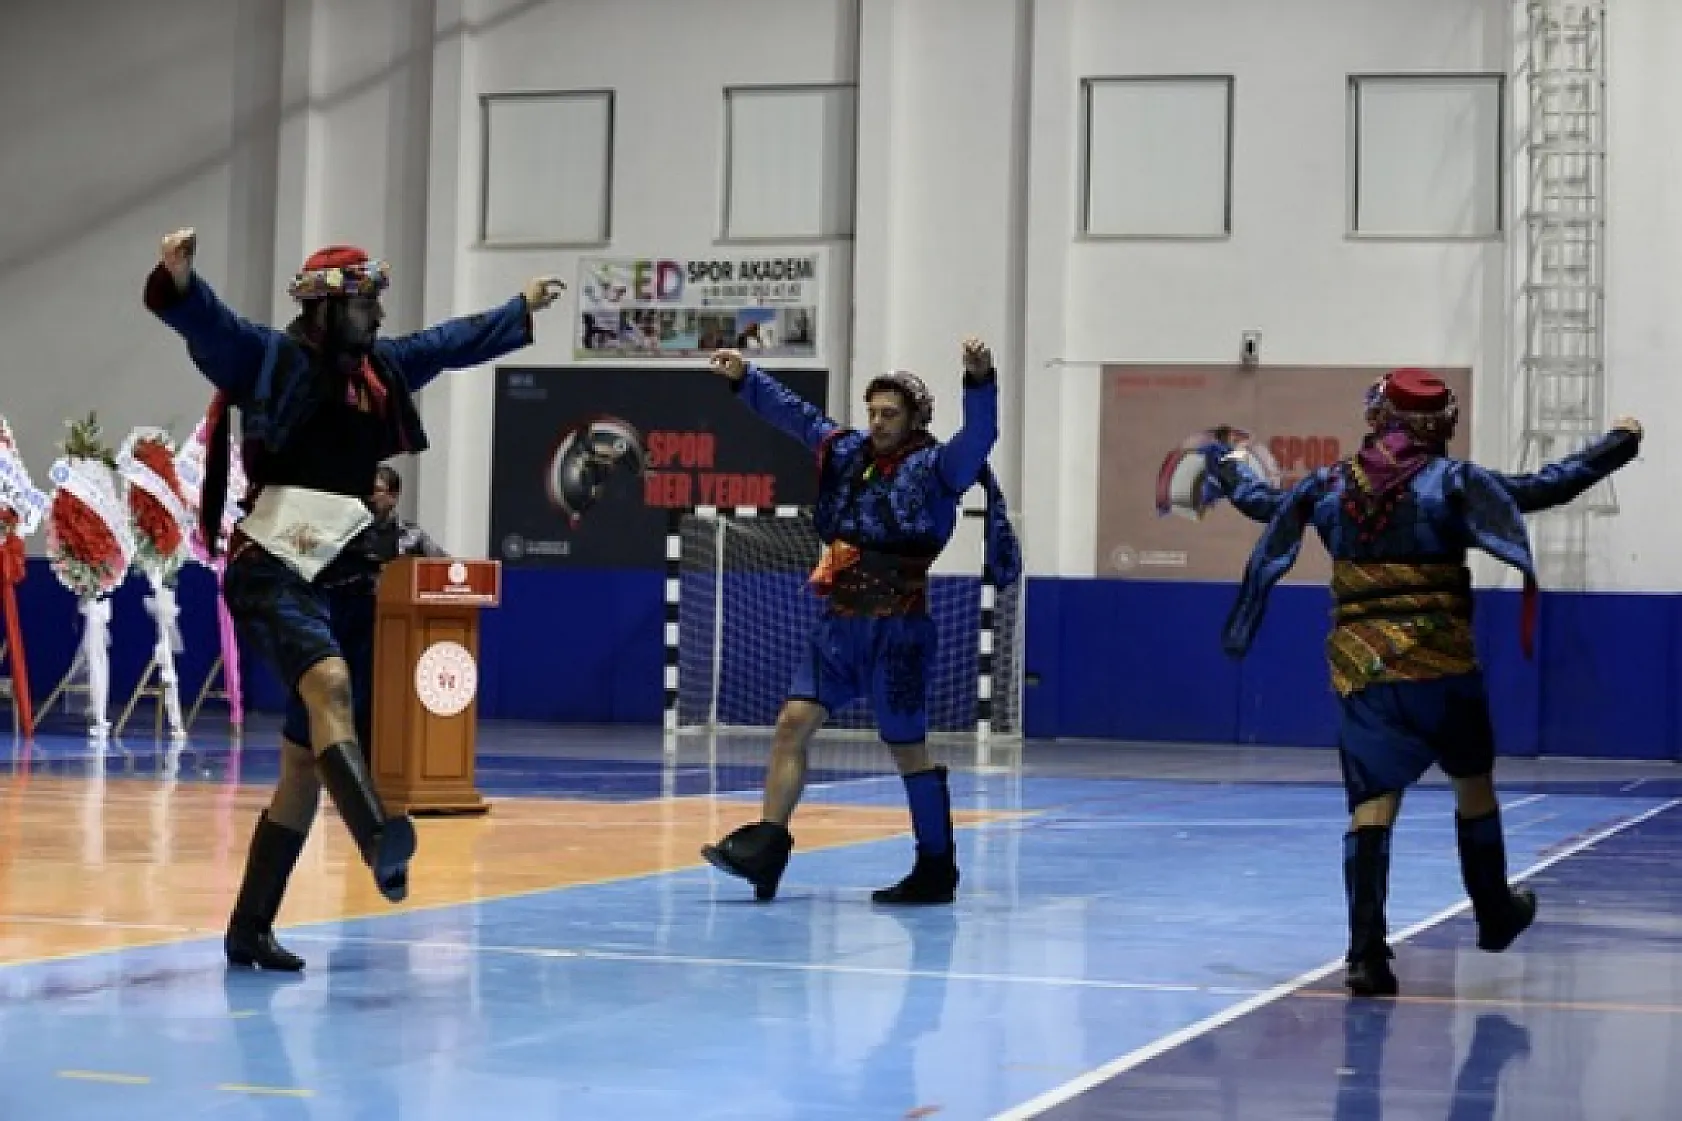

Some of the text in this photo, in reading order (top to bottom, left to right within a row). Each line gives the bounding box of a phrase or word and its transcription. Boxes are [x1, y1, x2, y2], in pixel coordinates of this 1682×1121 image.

[635, 260, 683, 301] ED
[687, 260, 733, 283] SPOR
[648, 432, 714, 468] SPOR
[1270, 435, 1340, 472] SPOR
[644, 472, 776, 508] HER YERDE
